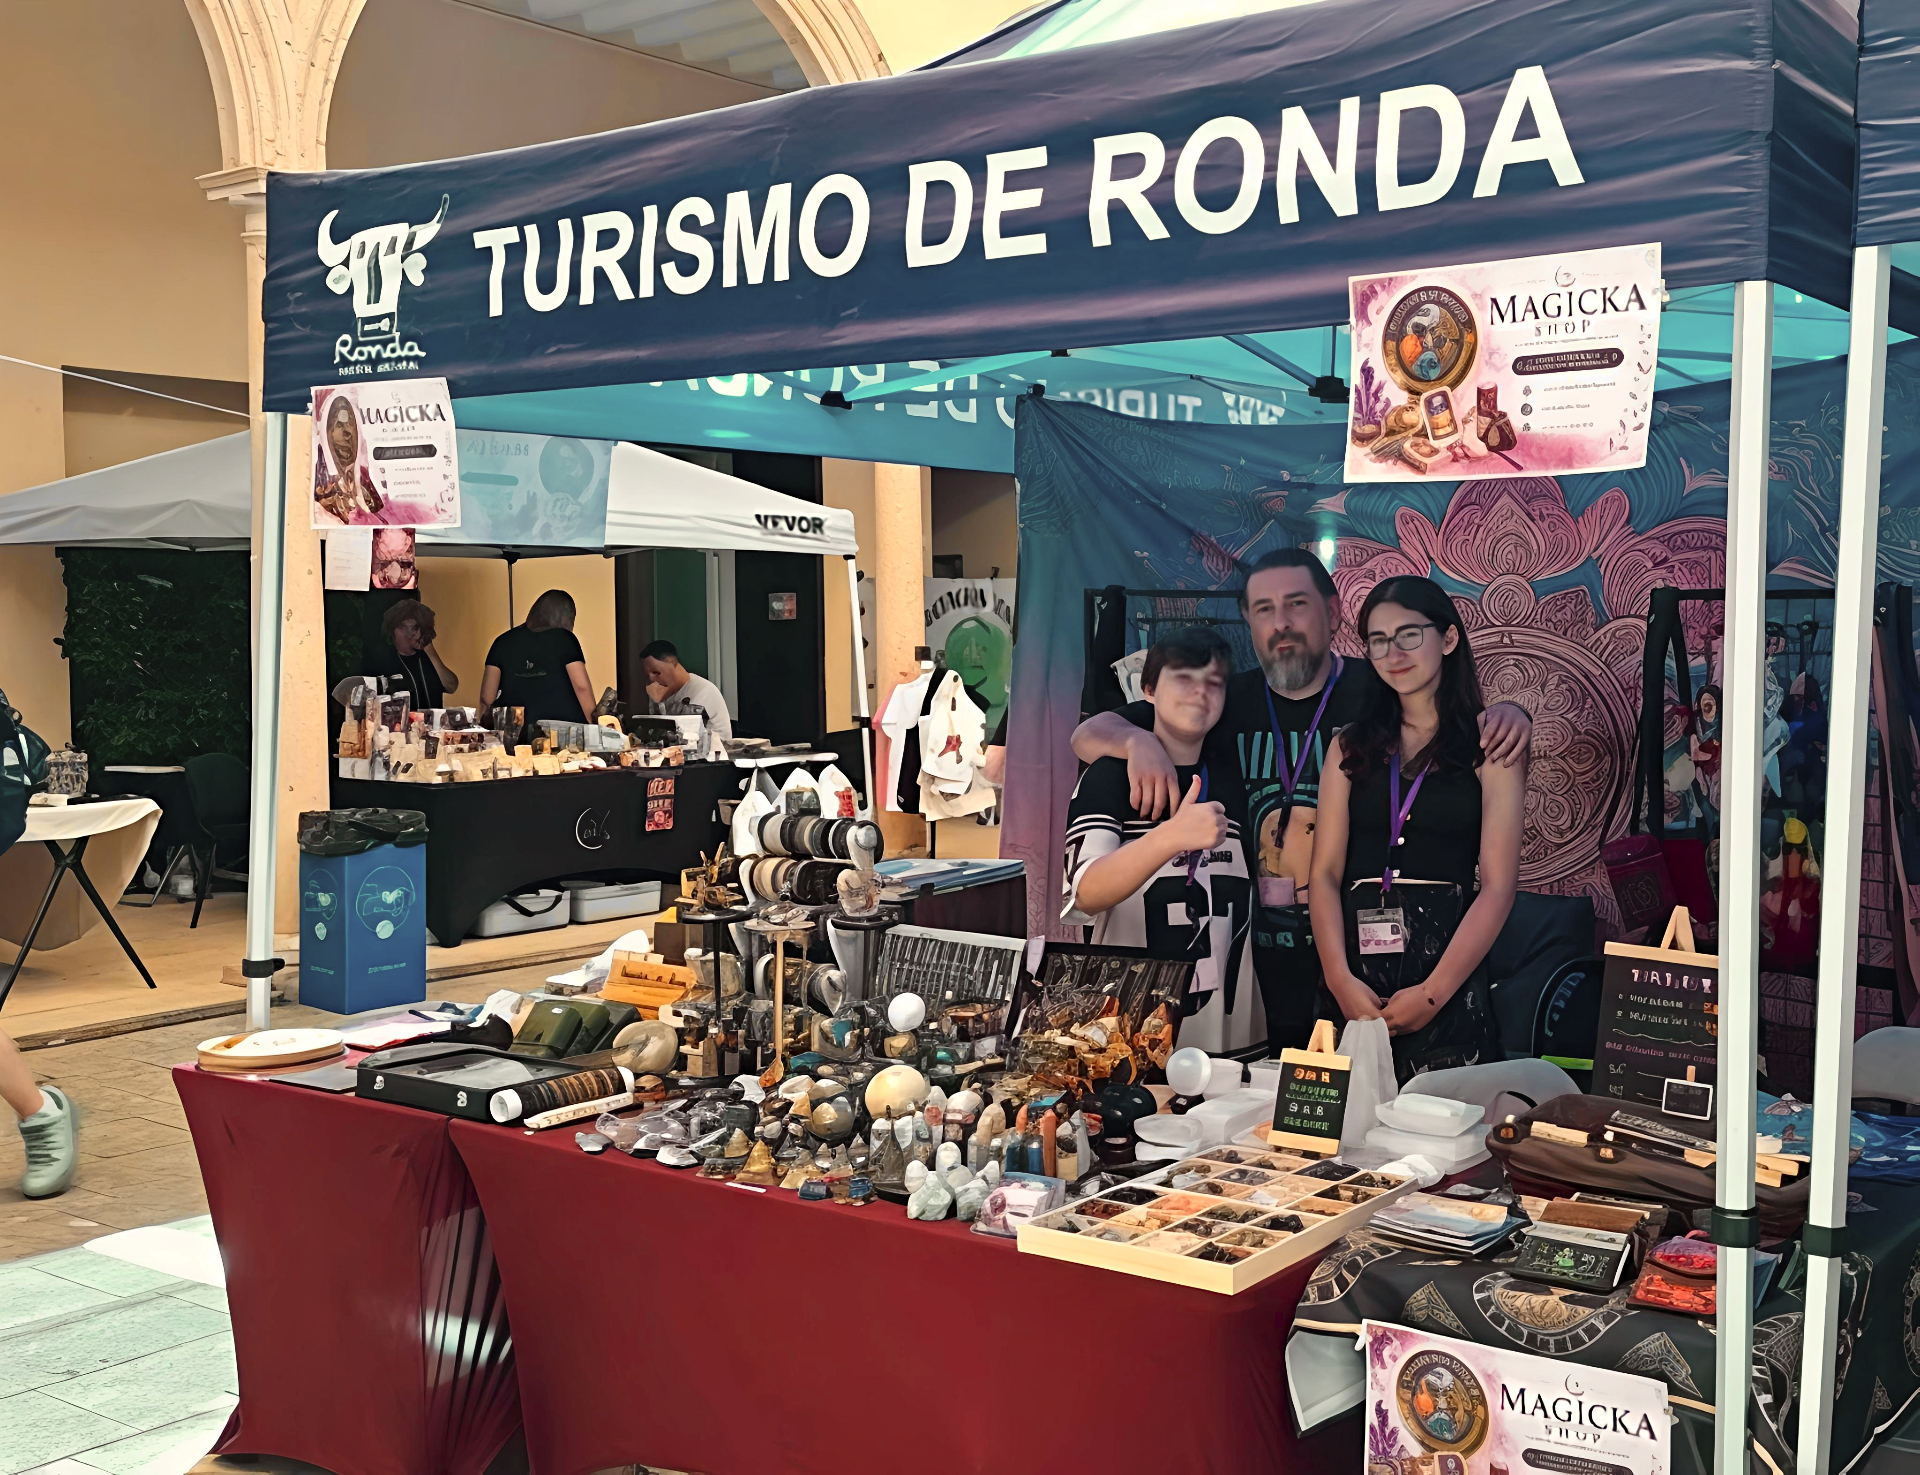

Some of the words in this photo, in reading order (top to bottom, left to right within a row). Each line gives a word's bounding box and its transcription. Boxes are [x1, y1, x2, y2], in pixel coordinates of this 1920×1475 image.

[473, 173, 870, 318] TURISMO
[905, 145, 1048, 269] DE
[1088, 64, 1586, 249] RONDA
[1489, 284, 1648, 326] MAGICKA
[333, 332, 427, 364] Ronda
[1499, 1383, 1658, 1441] MAGICKA
